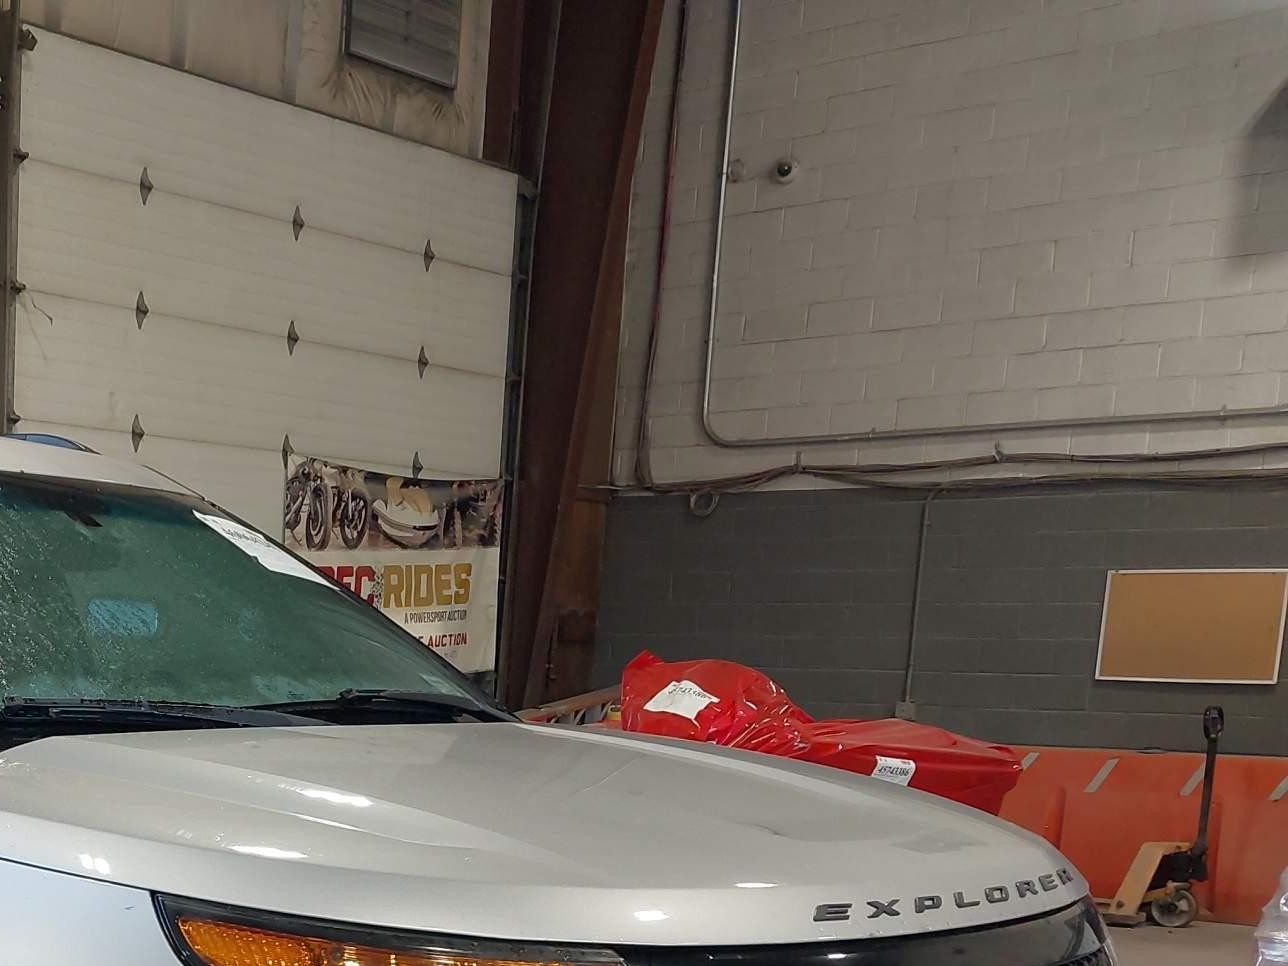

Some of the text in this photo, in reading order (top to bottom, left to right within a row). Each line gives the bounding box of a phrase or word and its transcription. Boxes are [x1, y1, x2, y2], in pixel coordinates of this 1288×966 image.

[317, 563, 472, 608] EC RIDES
[404, 609, 467, 625] A POWERSPORT AUCTION
[427, 632, 467, 648] AUCTION
[812, 868, 1074, 922] EXPLORER
